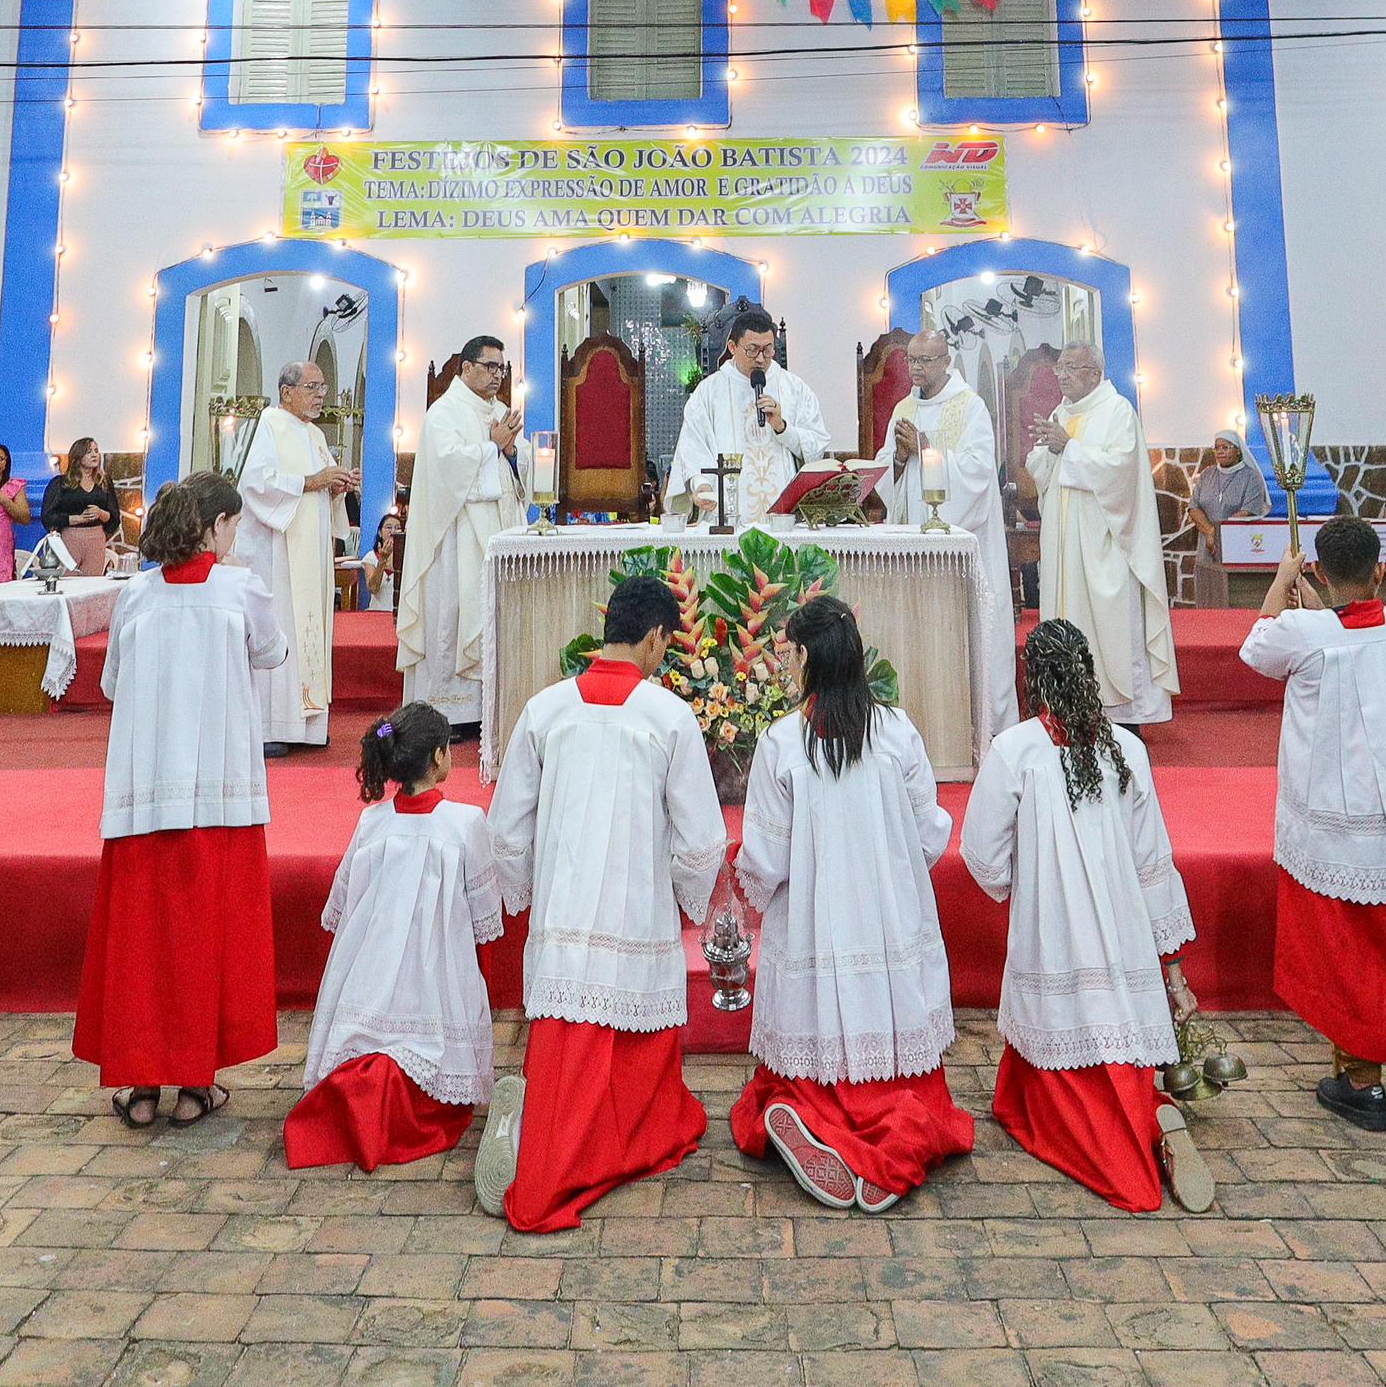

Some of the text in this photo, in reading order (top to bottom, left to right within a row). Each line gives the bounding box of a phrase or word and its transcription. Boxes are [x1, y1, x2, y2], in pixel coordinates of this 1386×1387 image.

[372, 144, 909, 171] FESTEJOS DE SÃO JOÃO BATISTA 2024
[503, 175, 614, 199] EXPRESSÃO
[619, 178, 645, 198] DE
[649, 178, 709, 198] AMOR
[718, 178, 730, 197] E
[735, 173, 838, 197] GRATIDÃO
[842, 175, 857, 195] A
[862, 174, 912, 195] DEUS
[377, 206, 913, 230] LEMA: DEUS AMA QUEM DAR COM ALEGRIA
